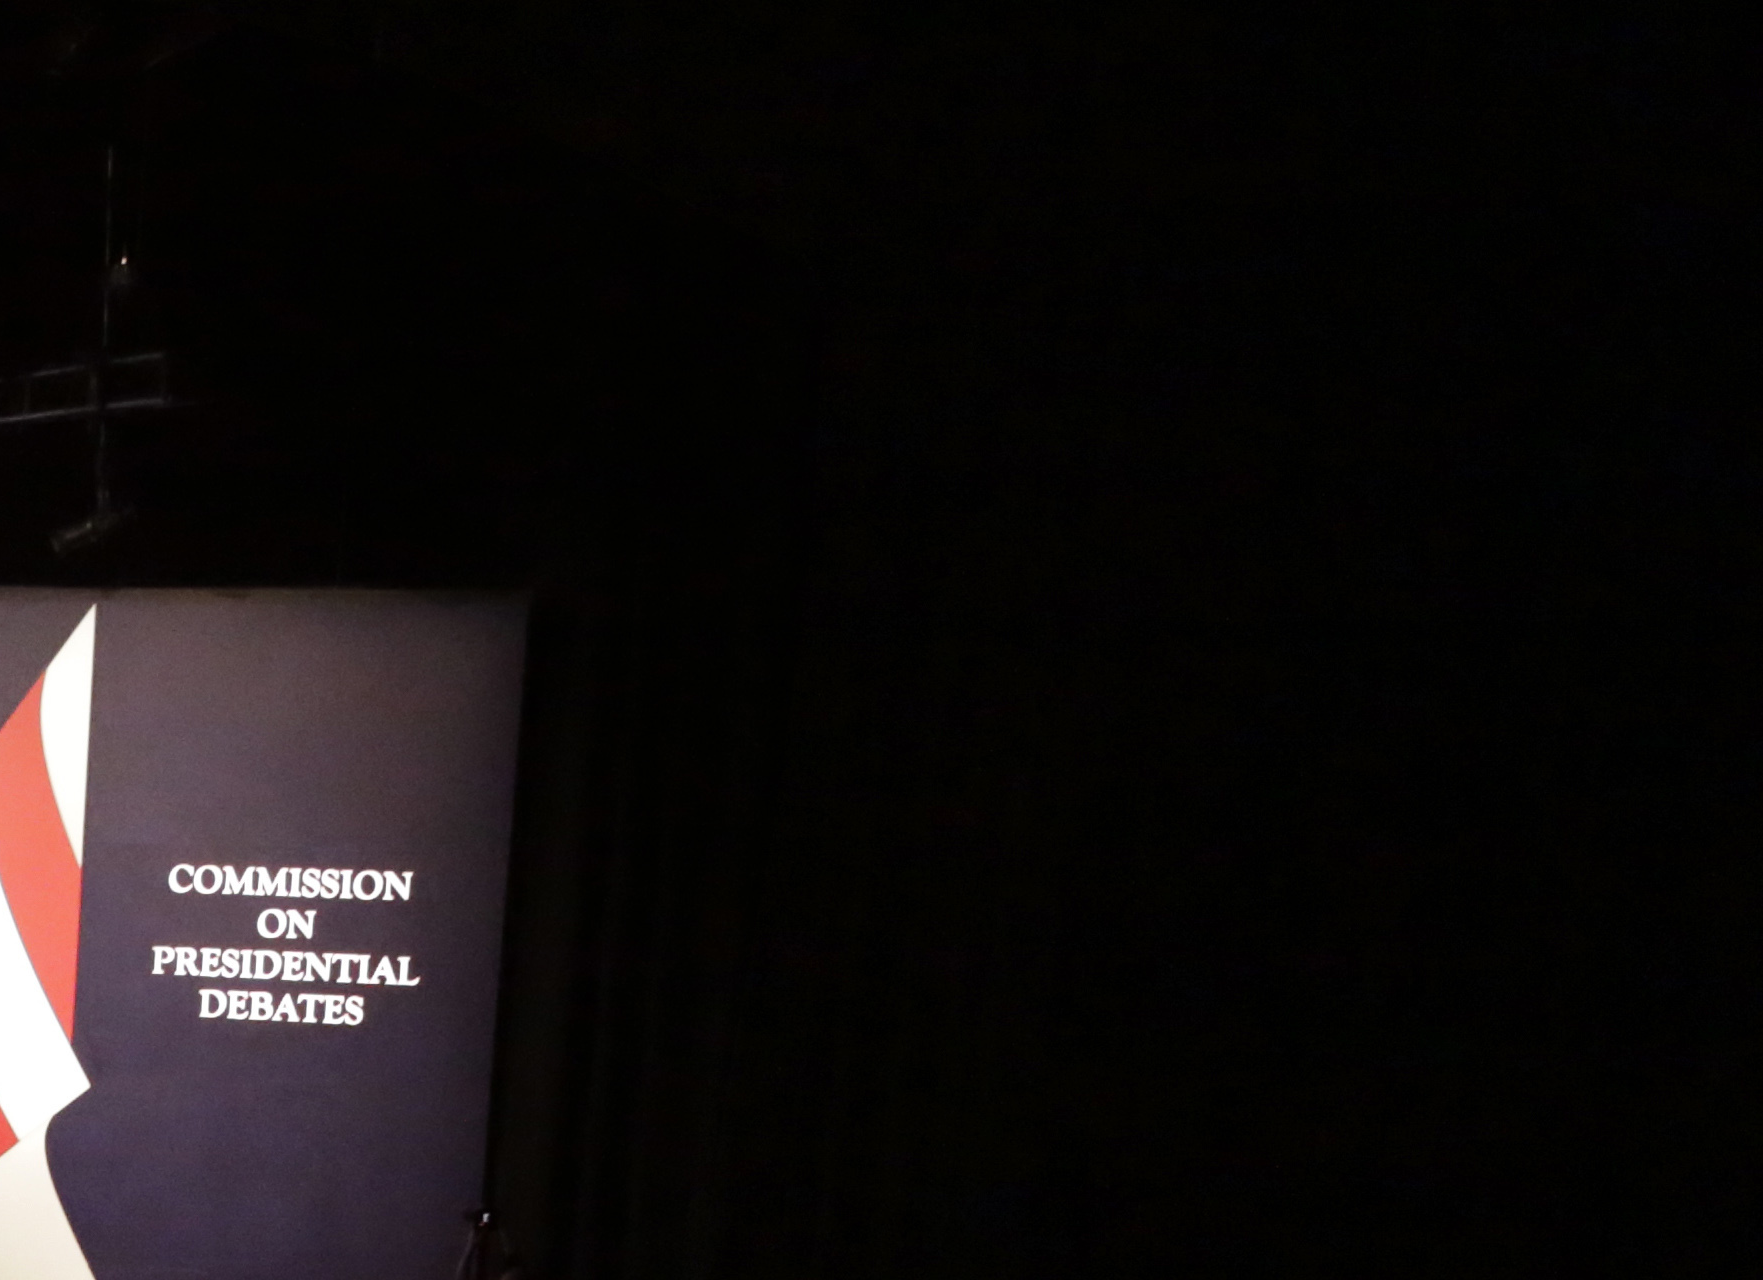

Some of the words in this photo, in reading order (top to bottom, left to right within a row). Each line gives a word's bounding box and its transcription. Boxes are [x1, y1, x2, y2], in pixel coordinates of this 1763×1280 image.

[168, 863, 414, 901] COMMISSION
[257, 908, 316, 939] ON
[152, 945, 420, 986] PRESIDENTIAL
[199, 989, 364, 1025] DEBATES
